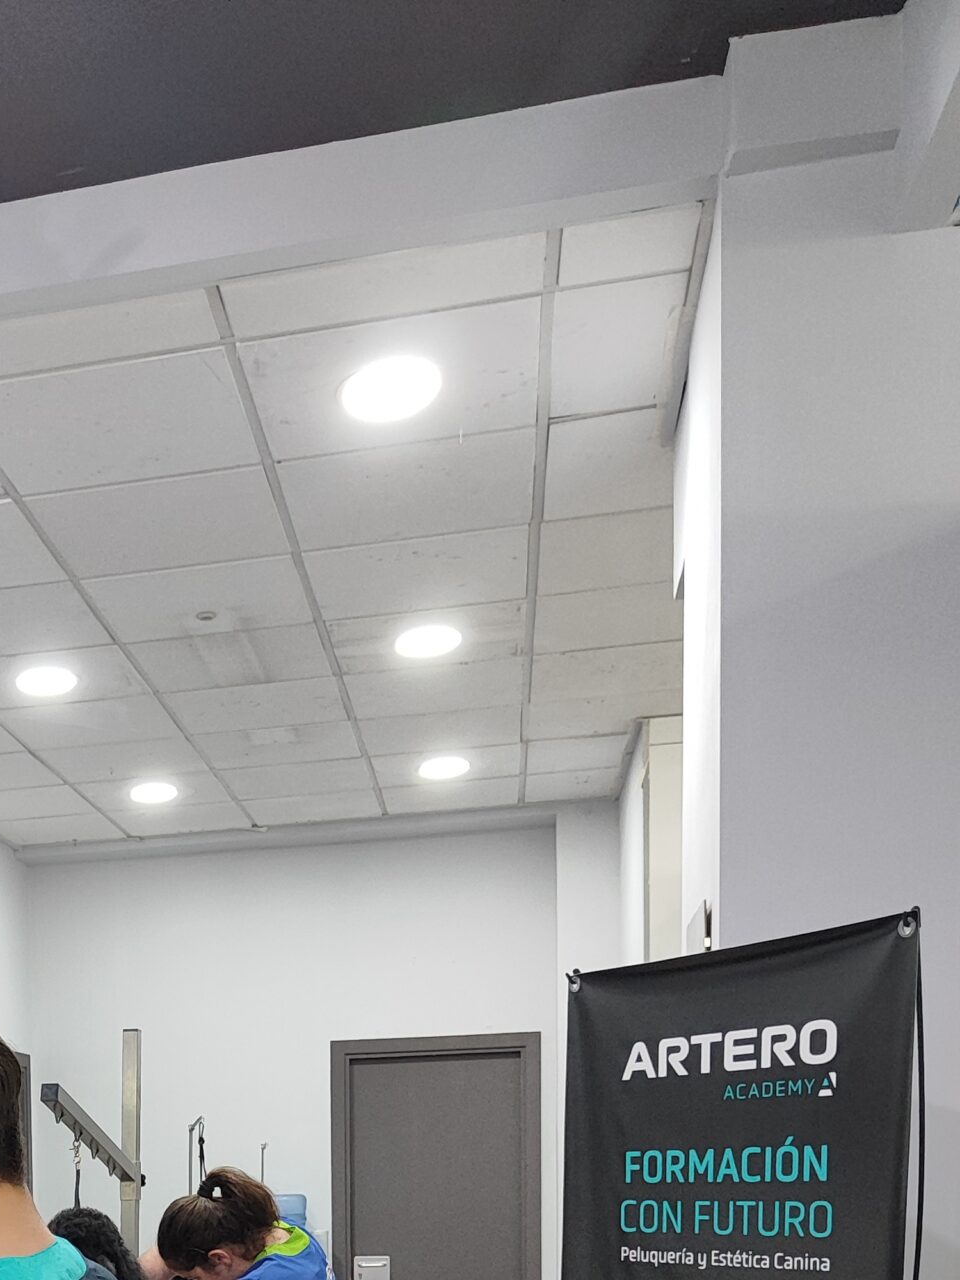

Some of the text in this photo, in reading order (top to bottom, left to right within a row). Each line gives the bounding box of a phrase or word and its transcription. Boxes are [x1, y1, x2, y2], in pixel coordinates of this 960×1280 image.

[621, 1019, 838, 1081] ARTERO
[723, 1078, 816, 1100] ACADEMY
[625, 1136, 828, 1184] FORMACIÓN
[620, 1199, 833, 1238] CON FUTURO
[620, 1246, 831, 1271] Peluquería y Estética Canina
